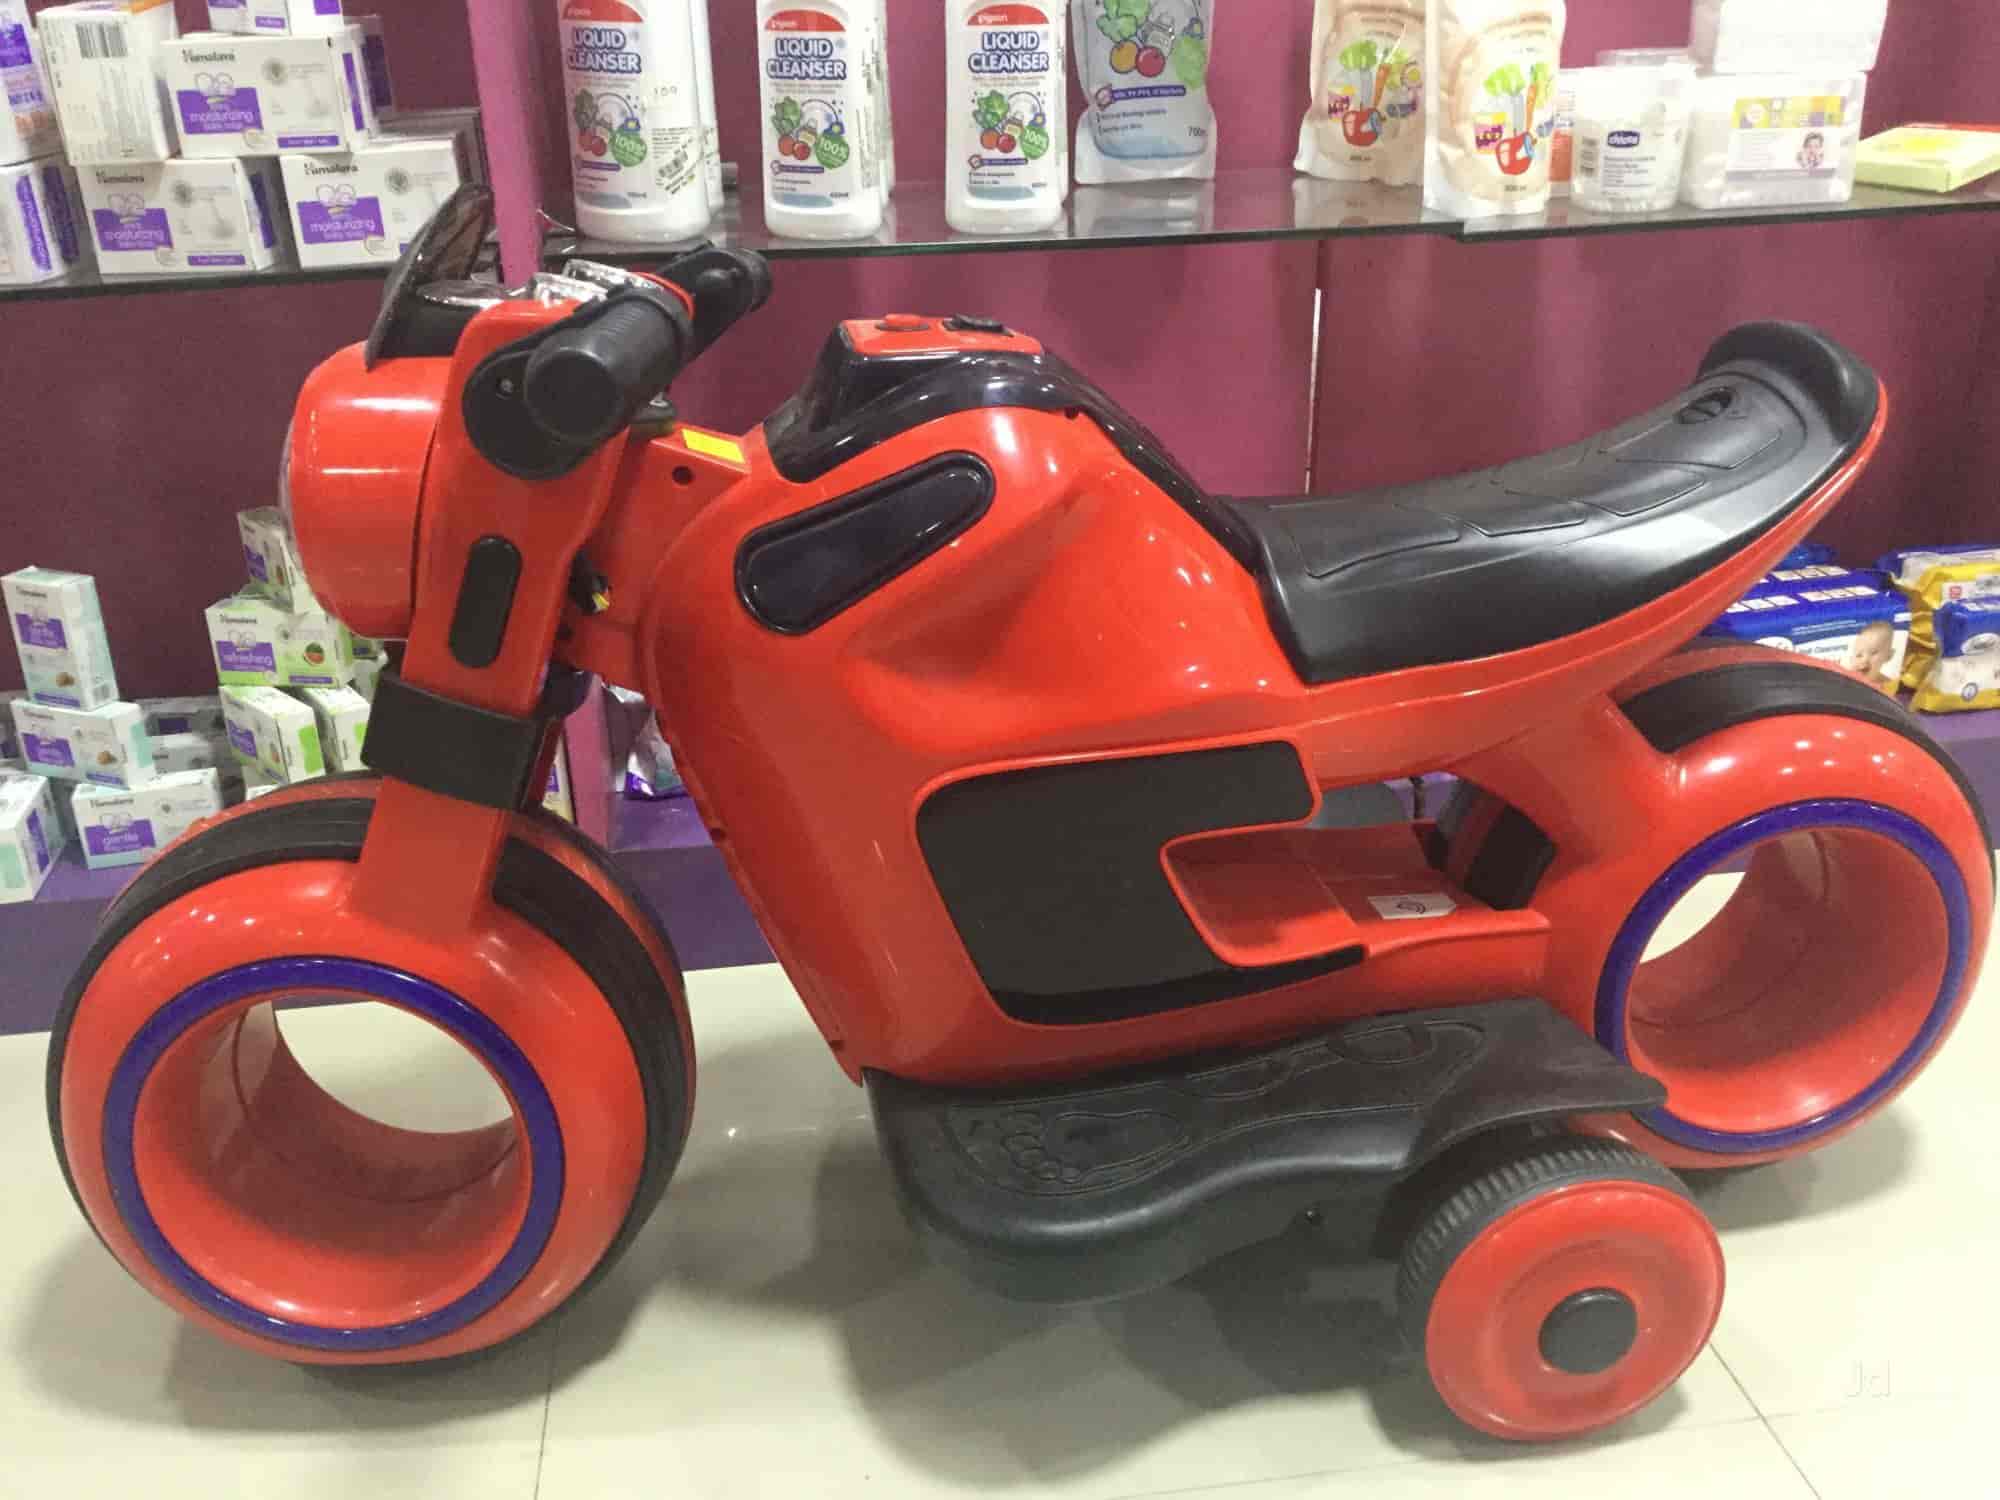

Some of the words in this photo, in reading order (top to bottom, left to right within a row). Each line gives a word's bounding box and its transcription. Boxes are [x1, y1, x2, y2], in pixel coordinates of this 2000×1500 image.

[573, 27, 626, 49] LIQUID
[775, 38, 834, 58] LIQUID
[981, 31, 1040, 52] LIQUID
[567, 50, 643, 73] CLEANSER
[766, 58, 847, 80] CLEANSER
[968, 52, 1049, 73] CLEANSER
